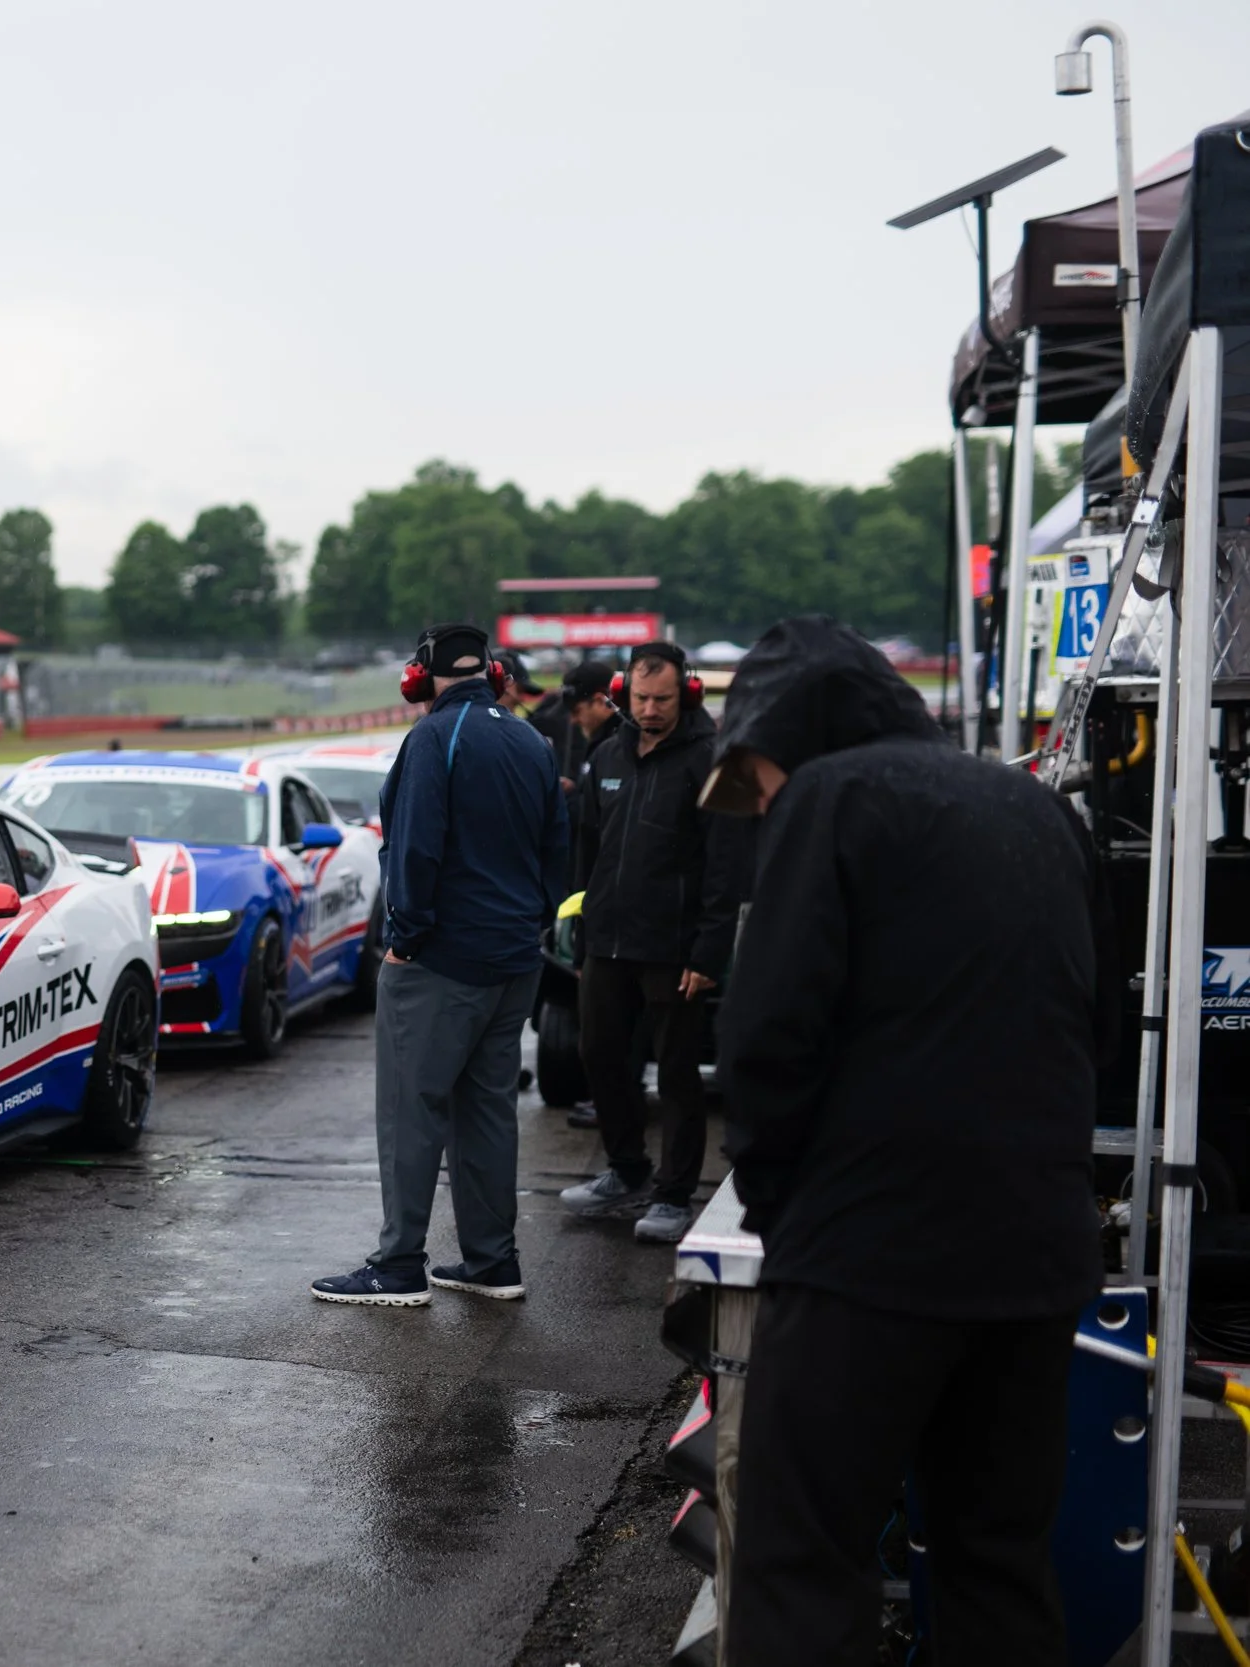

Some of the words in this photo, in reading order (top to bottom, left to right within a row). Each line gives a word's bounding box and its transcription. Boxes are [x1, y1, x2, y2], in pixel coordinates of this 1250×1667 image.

[1069, 589, 1100, 655] 13
[1061, 675, 1094, 754] KEEPER
[4, 1082, 43, 1112] RACING
